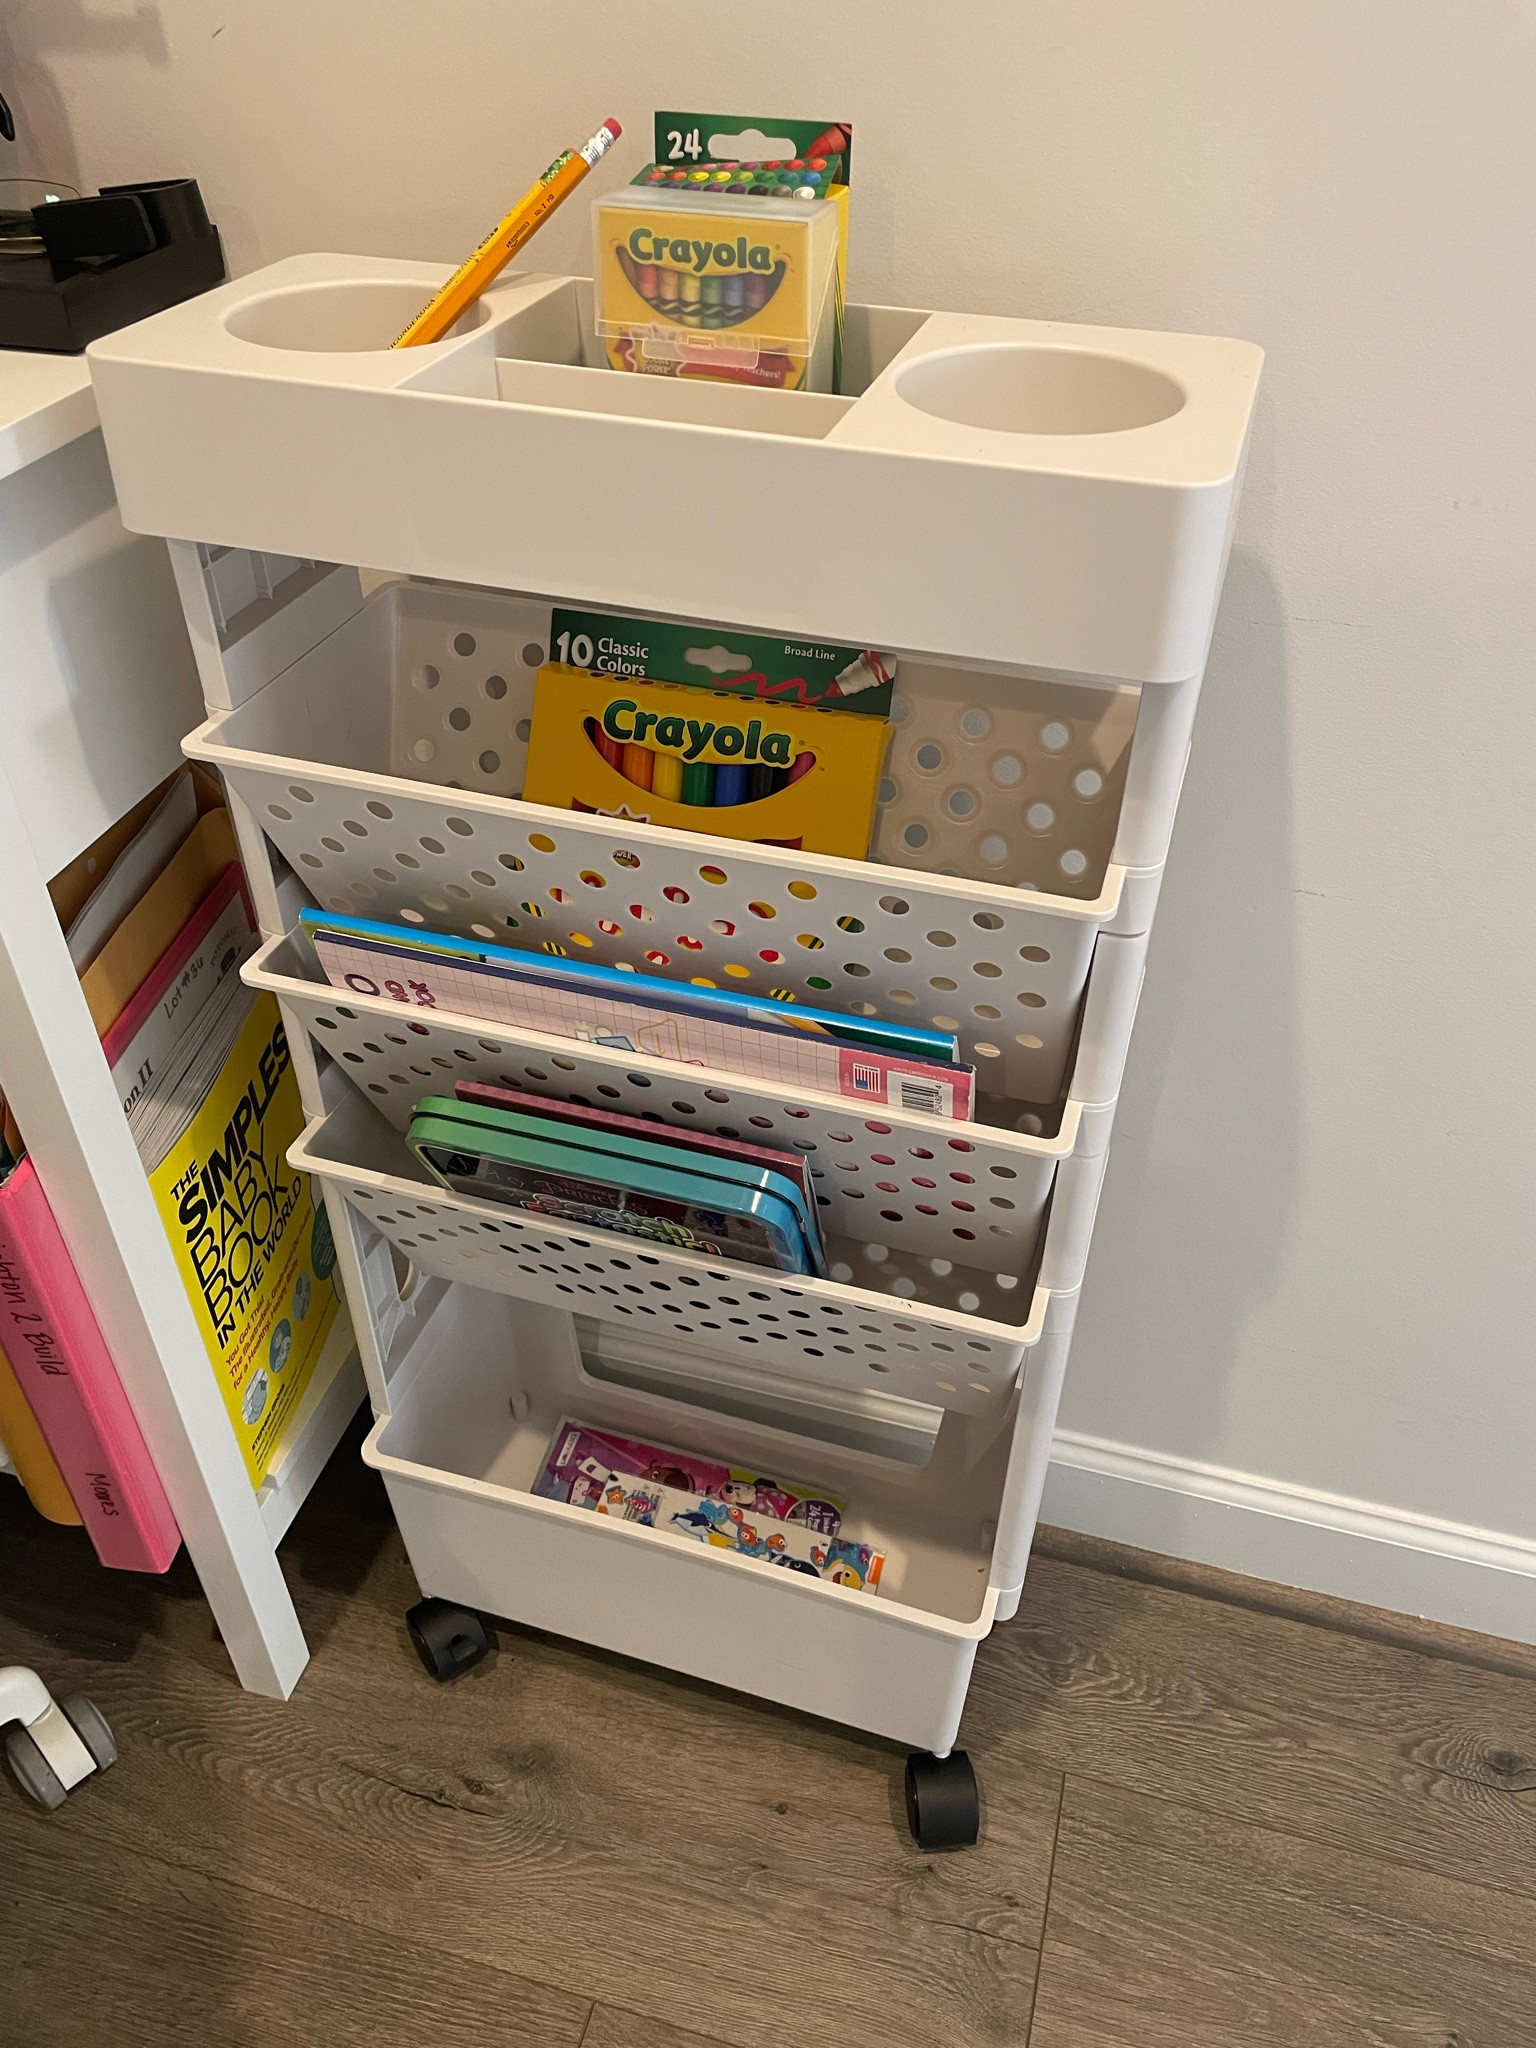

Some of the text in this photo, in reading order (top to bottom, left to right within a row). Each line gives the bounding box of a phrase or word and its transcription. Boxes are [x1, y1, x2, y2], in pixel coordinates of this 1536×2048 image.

[667, 129, 703, 160] 24
[629, 228, 772, 273] Crayola
[386, 299, 435, 350] ICONDEROGA
[556, 631, 594, 668] 10
[597, 656, 646, 677] Colors
[598, 637, 649, 660] Classic
[784, 645, 836, 661] Broad Line
[603, 700, 792, 765] Crayola
[164, 986, 183, 1020] Lot
[123, 1085, 140, 1114] on
[179, 1021, 291, 1244] SIMPLES
[170, 1159, 199, 1202] THE
[190, 1121, 269, 1290] BABY
[536, 1194, 692, 1241] Scratch
[204, 1154, 288, 1330] BOOK
[217, 1176, 302, 1350] IN THE WORLD
[0, 1244, 69, 1376] hton 2 Build
[226, 1345, 240, 1366] You
[240, 1322, 251, 1345] Got
[229, 1357, 243, 1377] The
[233, 1373, 243, 1391] for
